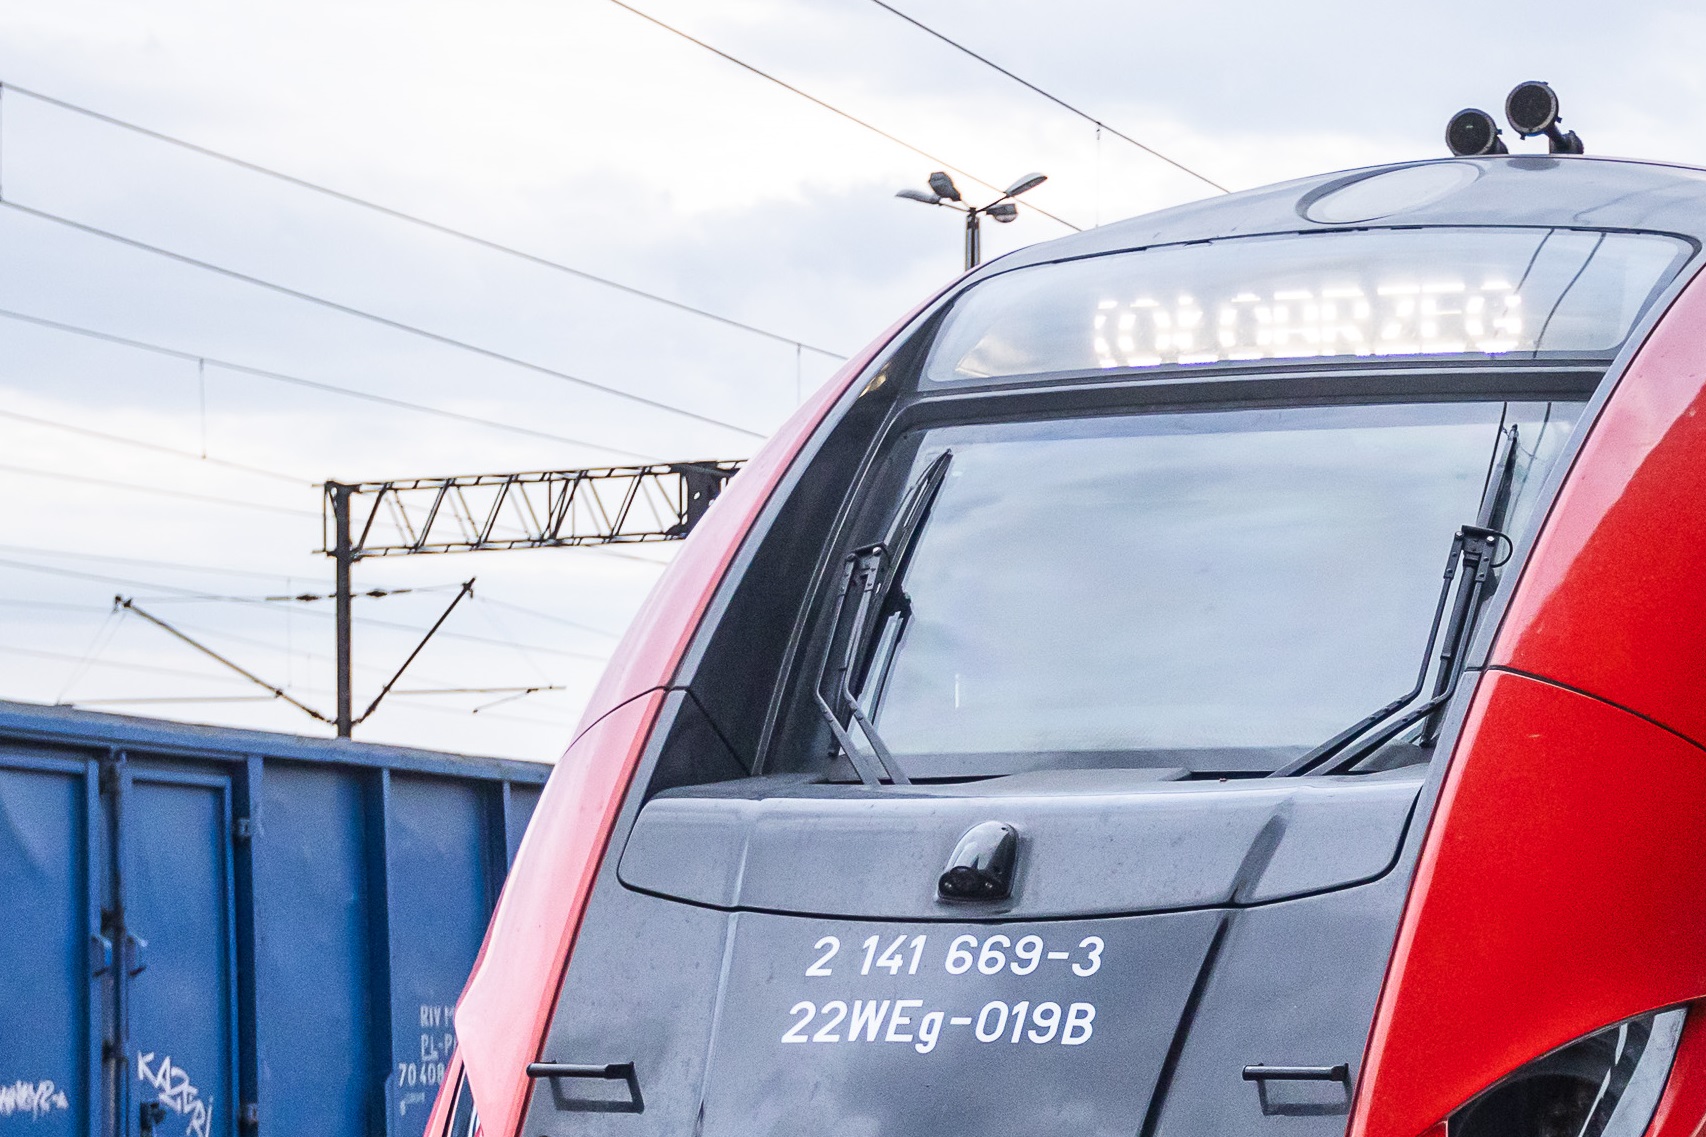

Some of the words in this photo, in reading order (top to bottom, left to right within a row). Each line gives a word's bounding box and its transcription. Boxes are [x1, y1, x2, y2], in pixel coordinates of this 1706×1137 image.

[805, 935, 841, 977] 2
[860, 934, 928, 976] 141
[944, 934, 1105, 977] 669-3
[421, 1033, 457, 1058] PL-P
[781, 1000, 1097, 1054] 22WEg-019B
